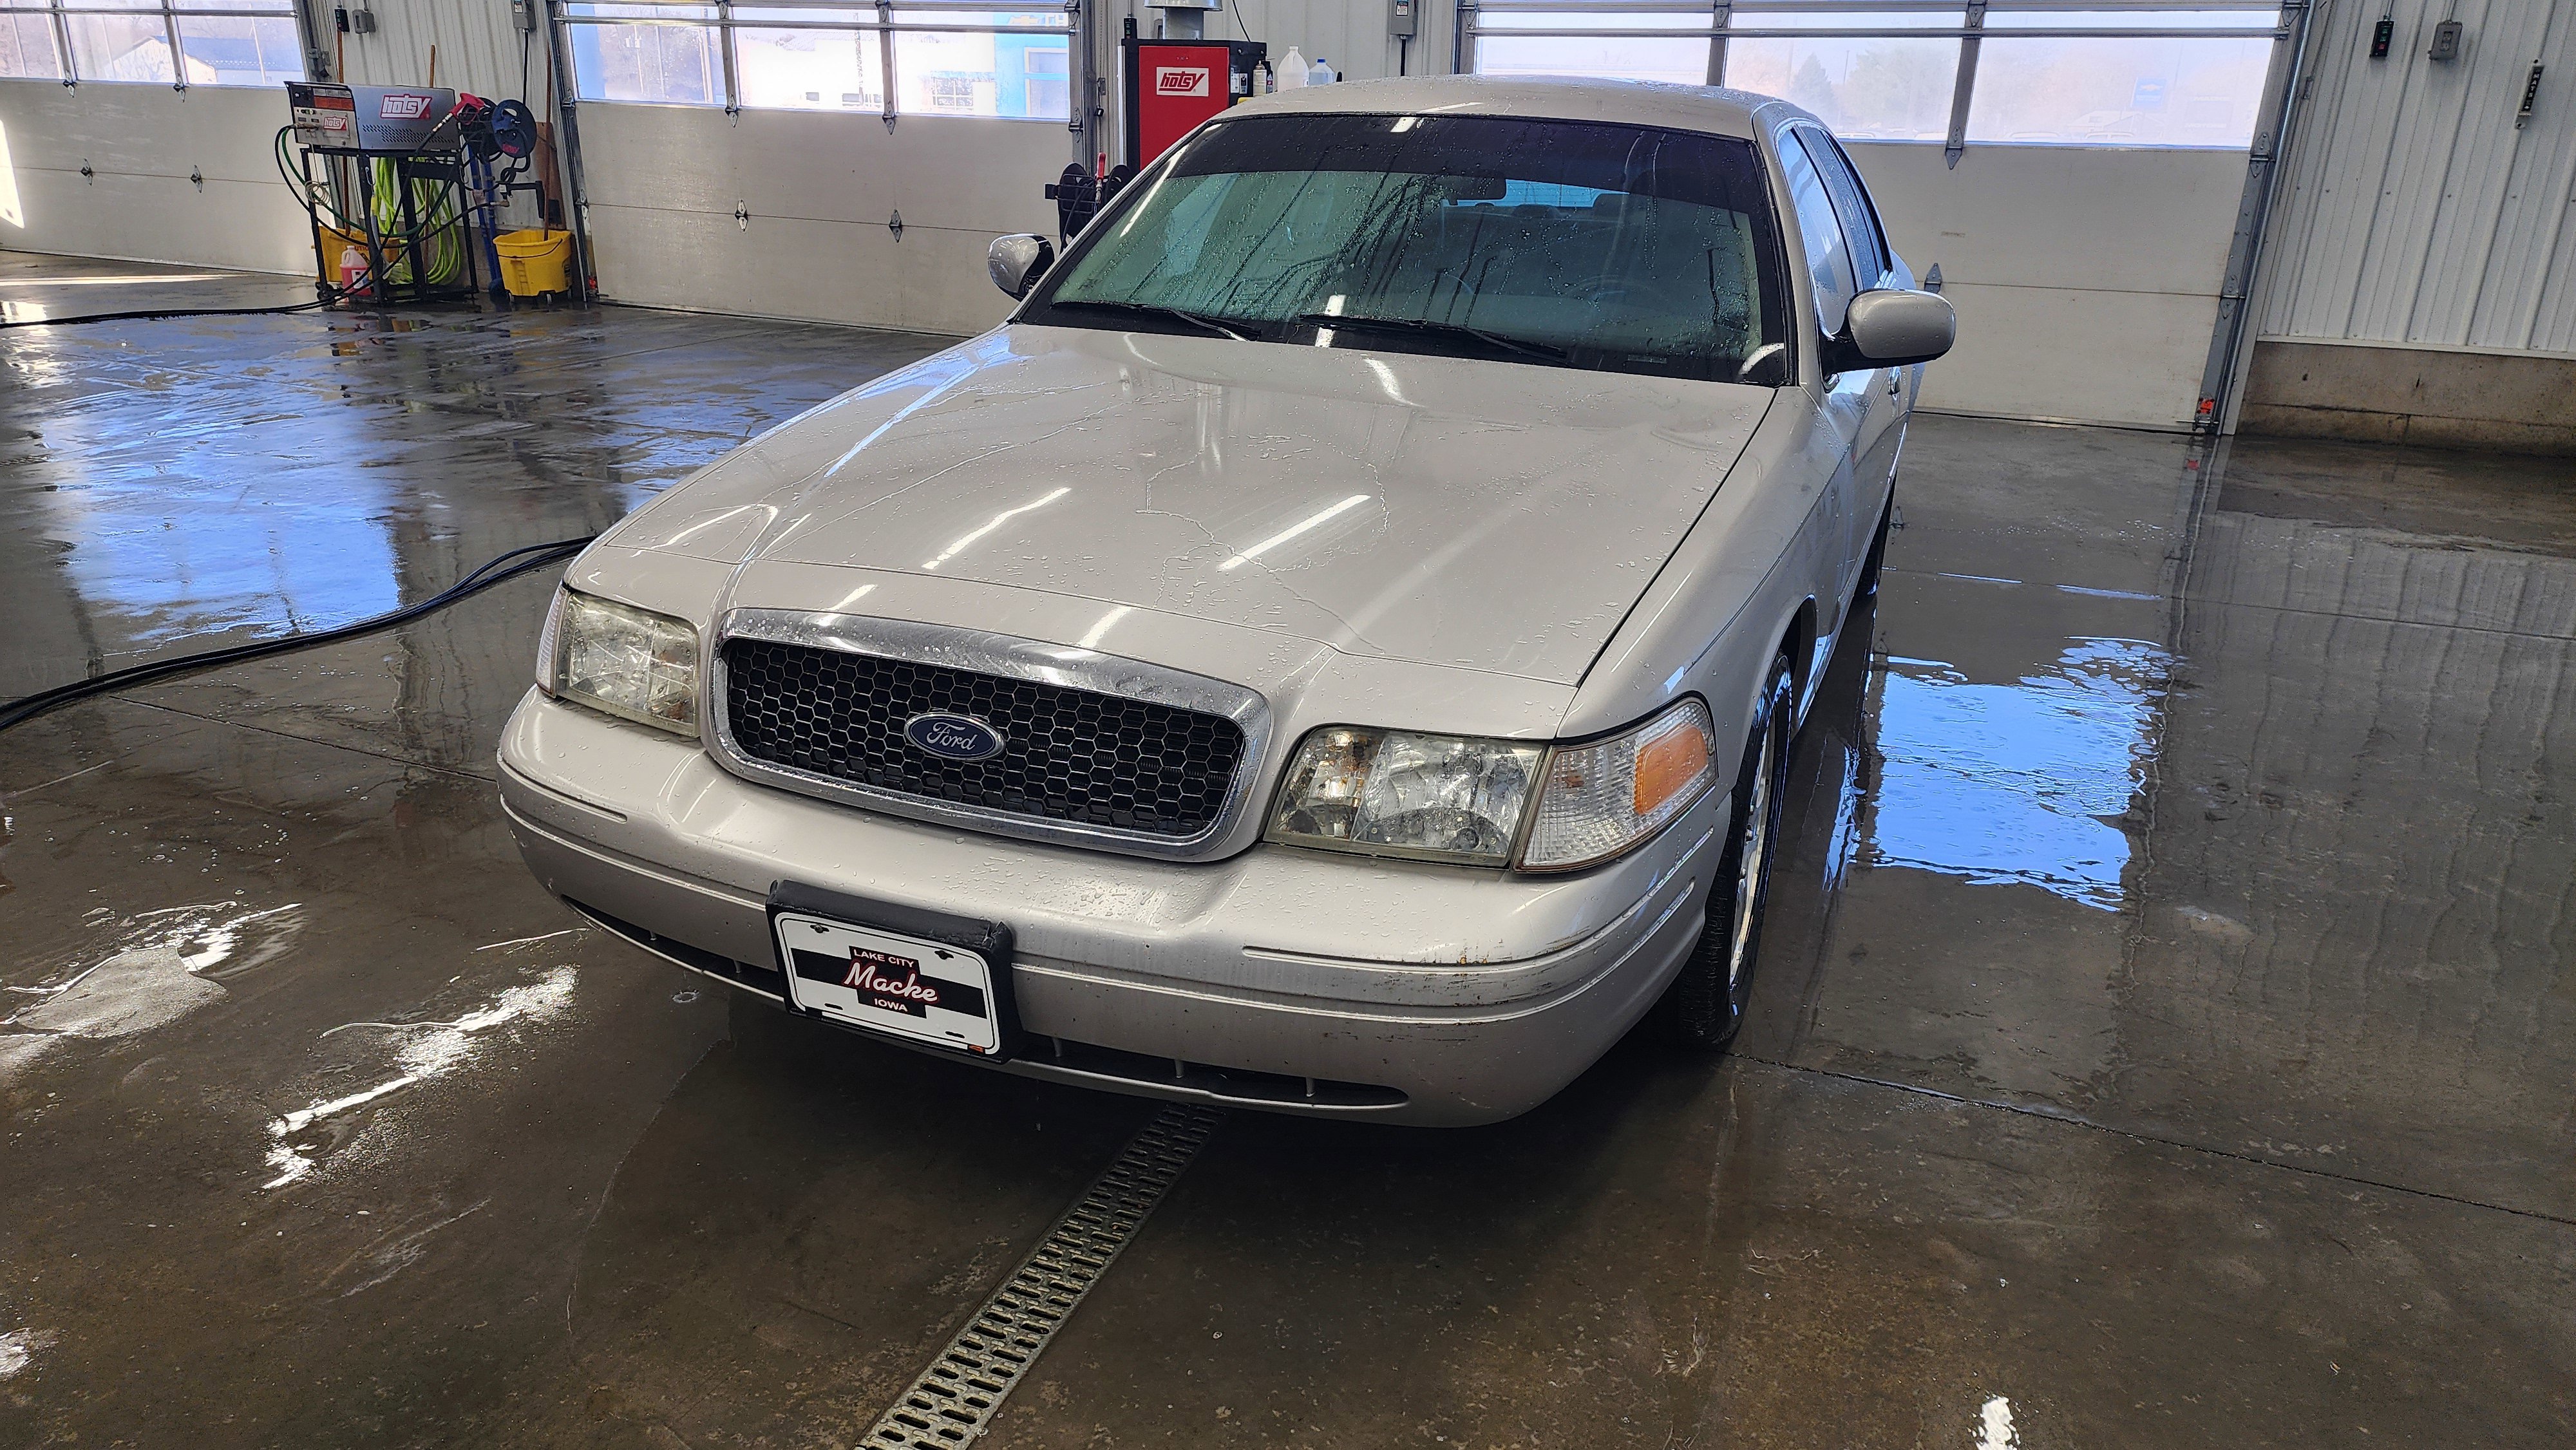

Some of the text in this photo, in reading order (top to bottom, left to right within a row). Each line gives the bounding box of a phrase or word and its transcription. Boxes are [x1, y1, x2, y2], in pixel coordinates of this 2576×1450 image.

[1159, 71, 1206, 91] hotsy
[381, 95, 431, 118] hotsy
[323, 117, 346, 129] hotsy
[926, 722, 978, 750] Ford
[853, 949, 914, 968] LAKE CITY
[844, 962, 938, 1002] Macke
[874, 998, 908, 1012] IOWA
